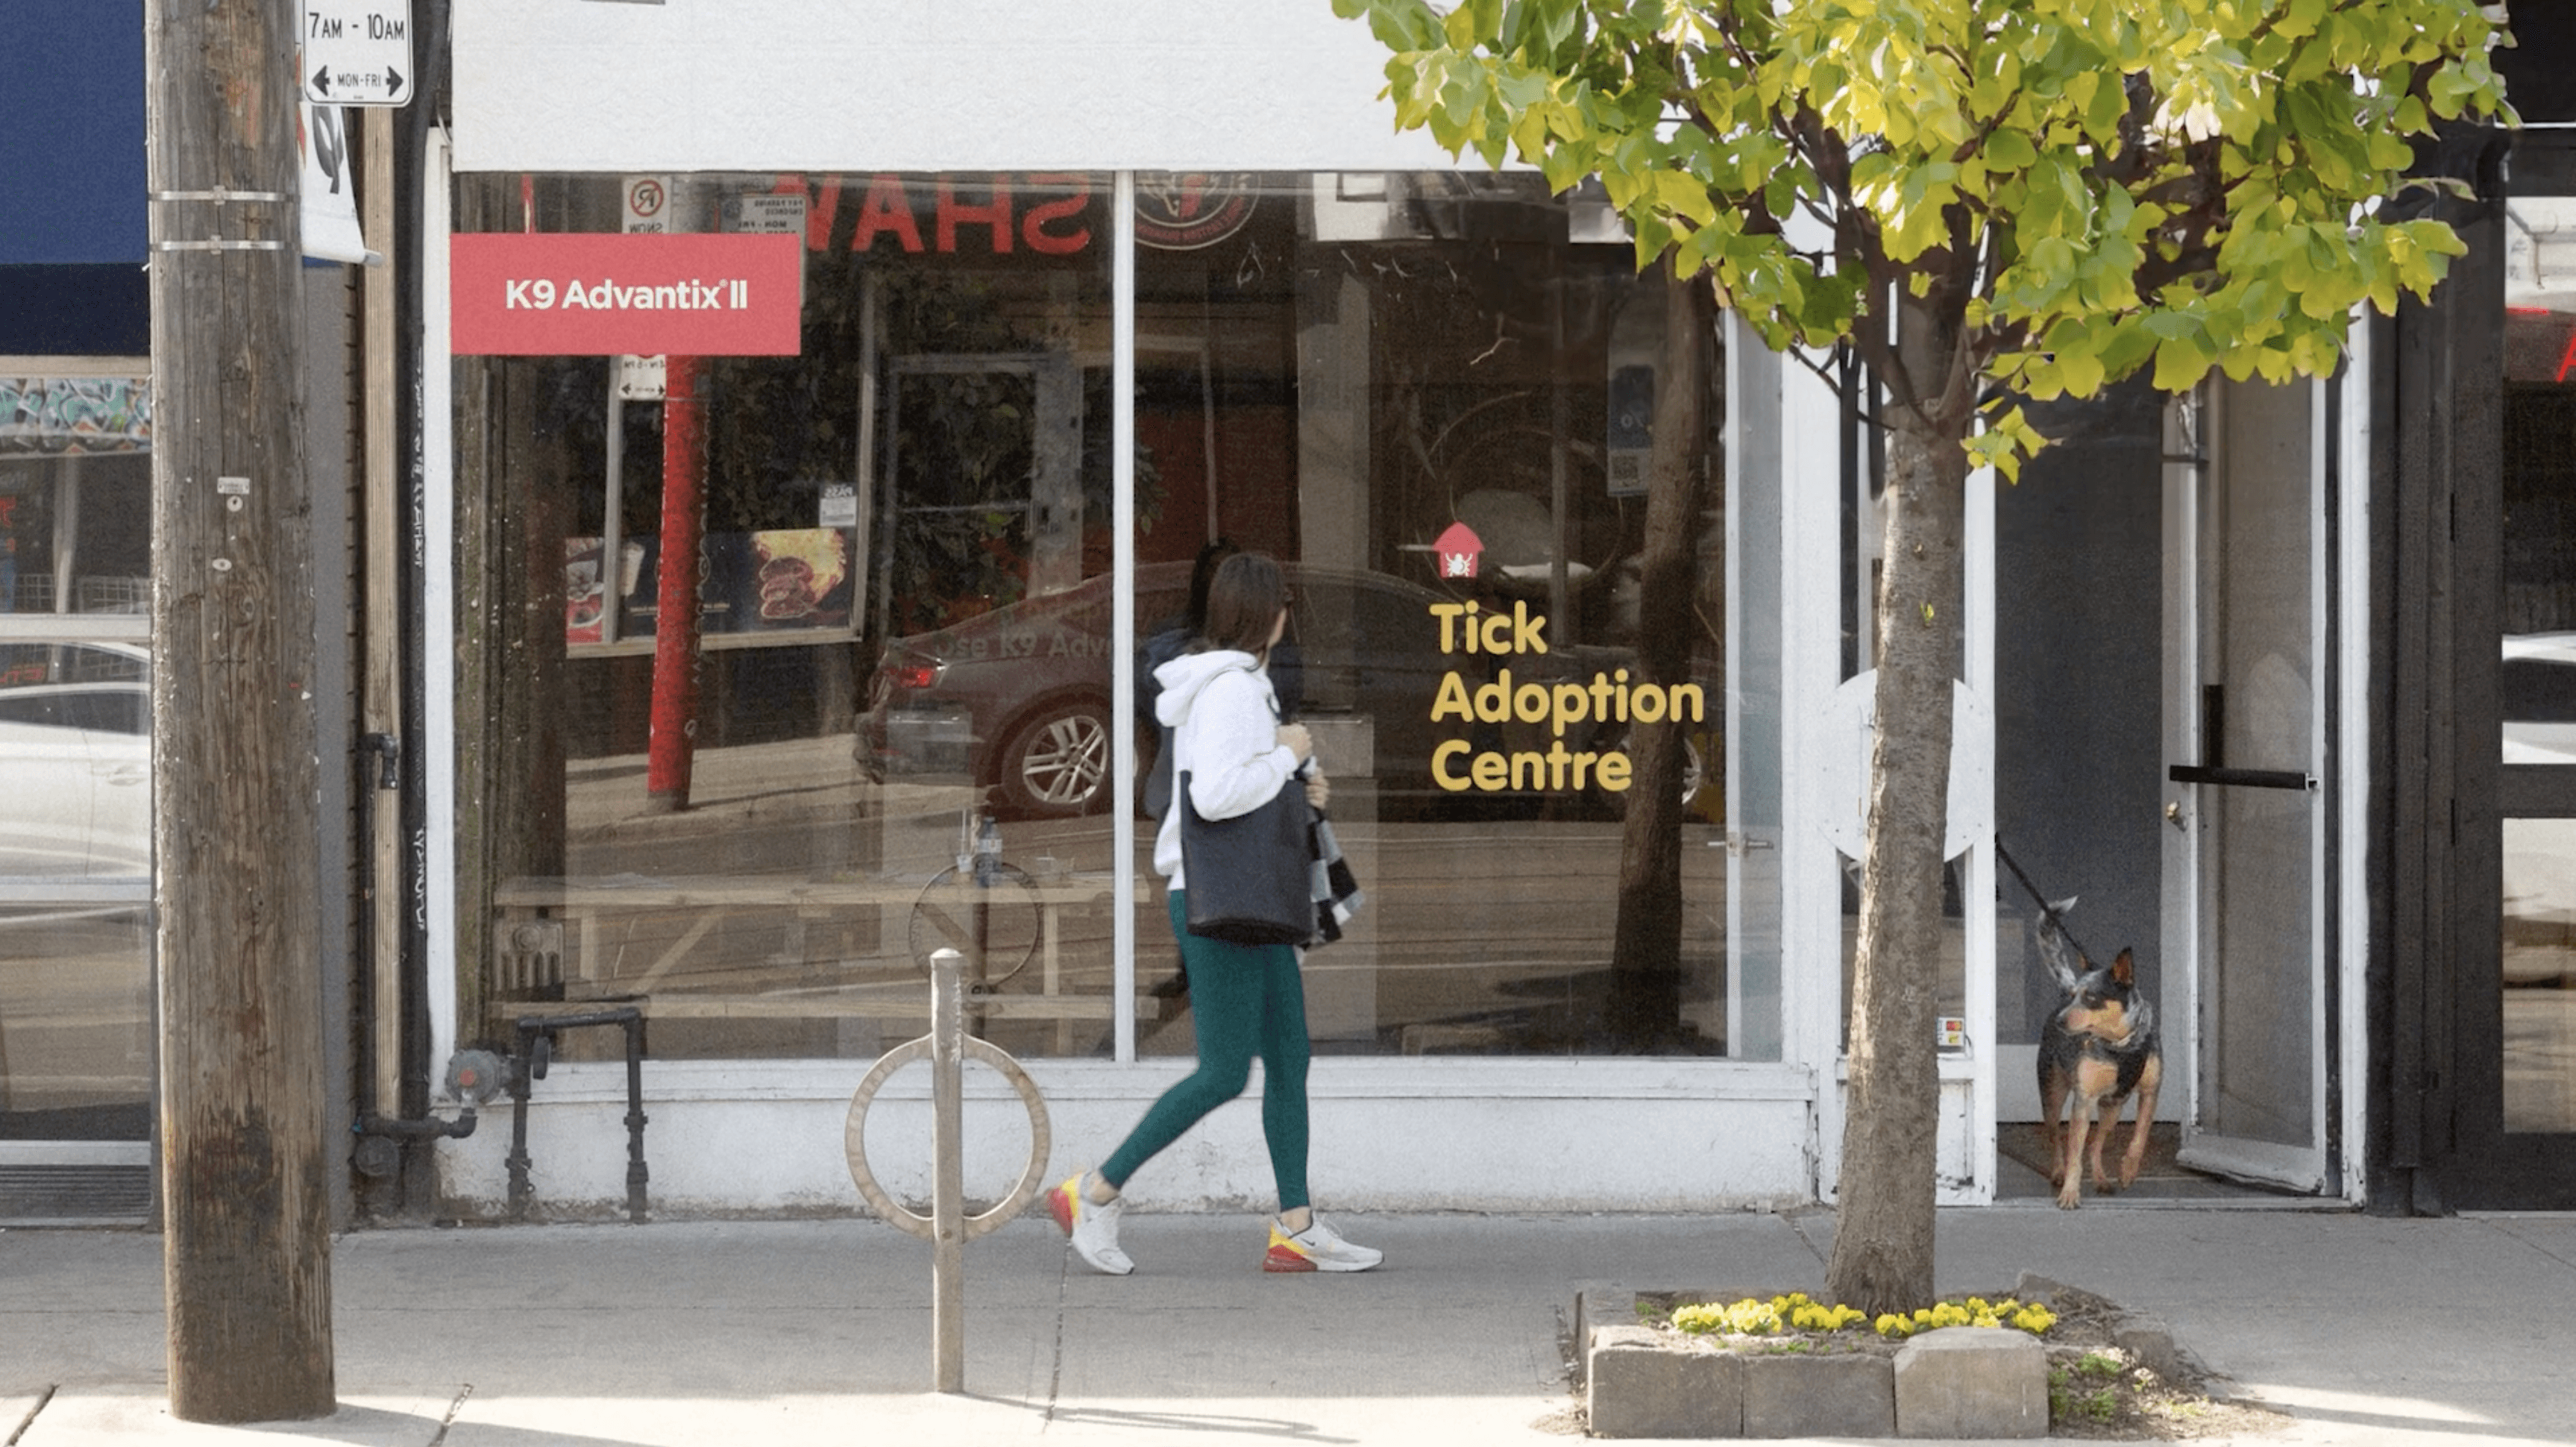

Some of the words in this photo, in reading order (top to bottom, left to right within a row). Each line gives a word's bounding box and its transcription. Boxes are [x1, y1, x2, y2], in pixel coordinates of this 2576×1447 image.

[308, 12, 342, 39] 7AM
[367, 13, 405, 40] 10AM
[337, 73, 382, 87] MON-FRI
[506, 279, 556, 310] K9
[1428, 600, 1548, 655] Tick
[1430, 668, 1704, 737] Adoption
[1430, 739, 1633, 792] Centre
